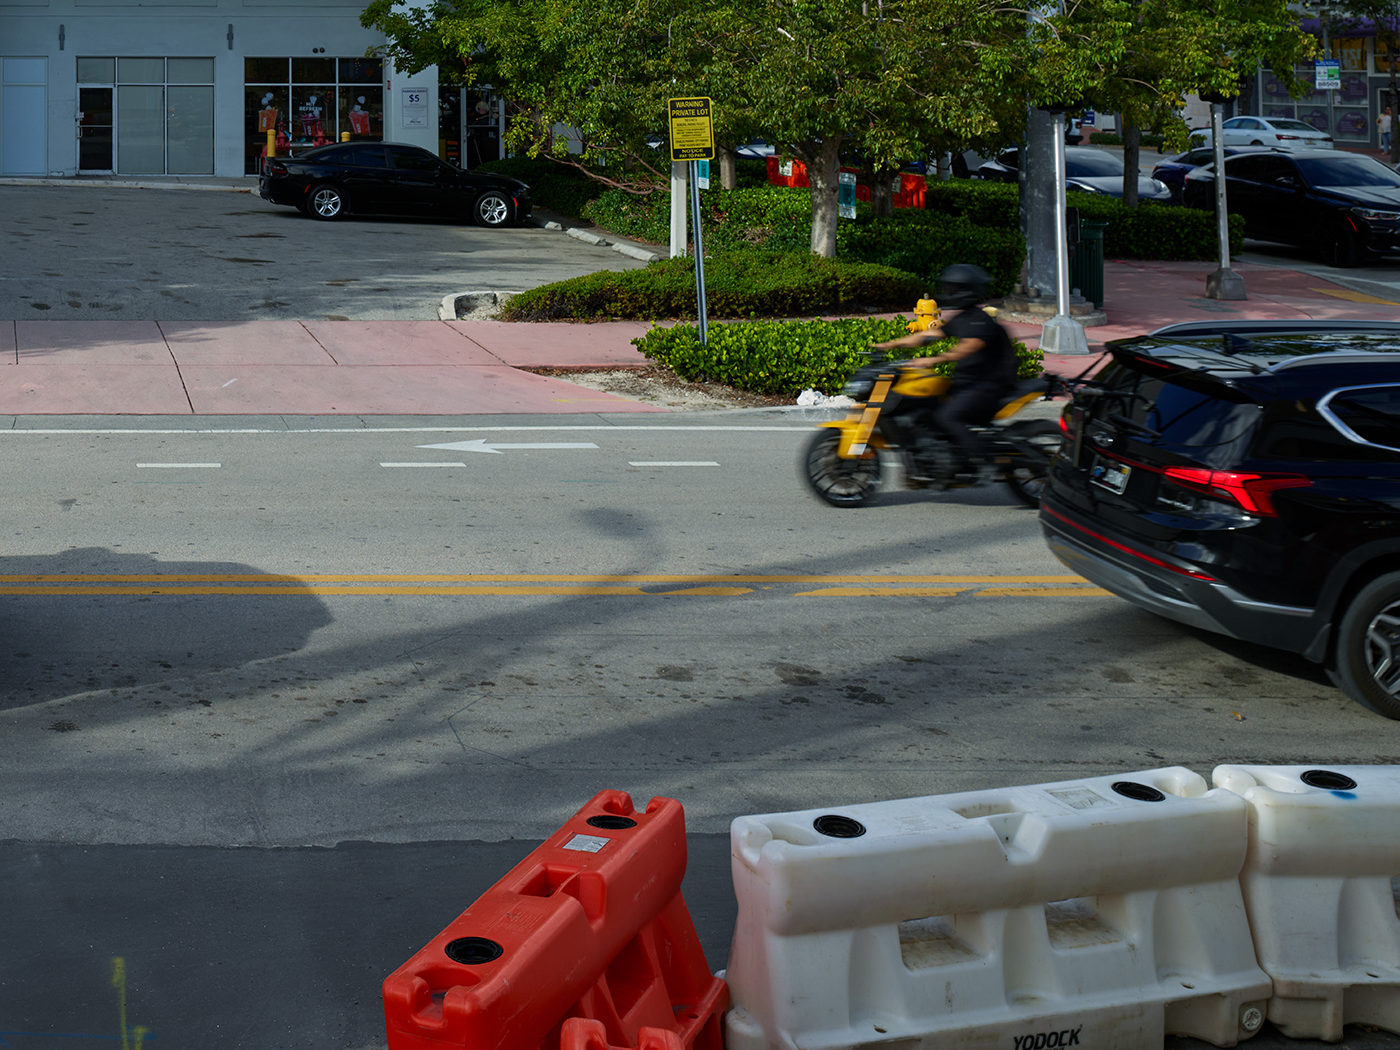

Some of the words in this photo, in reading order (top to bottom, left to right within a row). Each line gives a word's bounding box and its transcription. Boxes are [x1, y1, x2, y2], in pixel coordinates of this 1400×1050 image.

[409, 94, 420, 103] $5
[676, 100, 704, 108] WARNING
[1013, 1028, 1083, 1050] YODOCK
